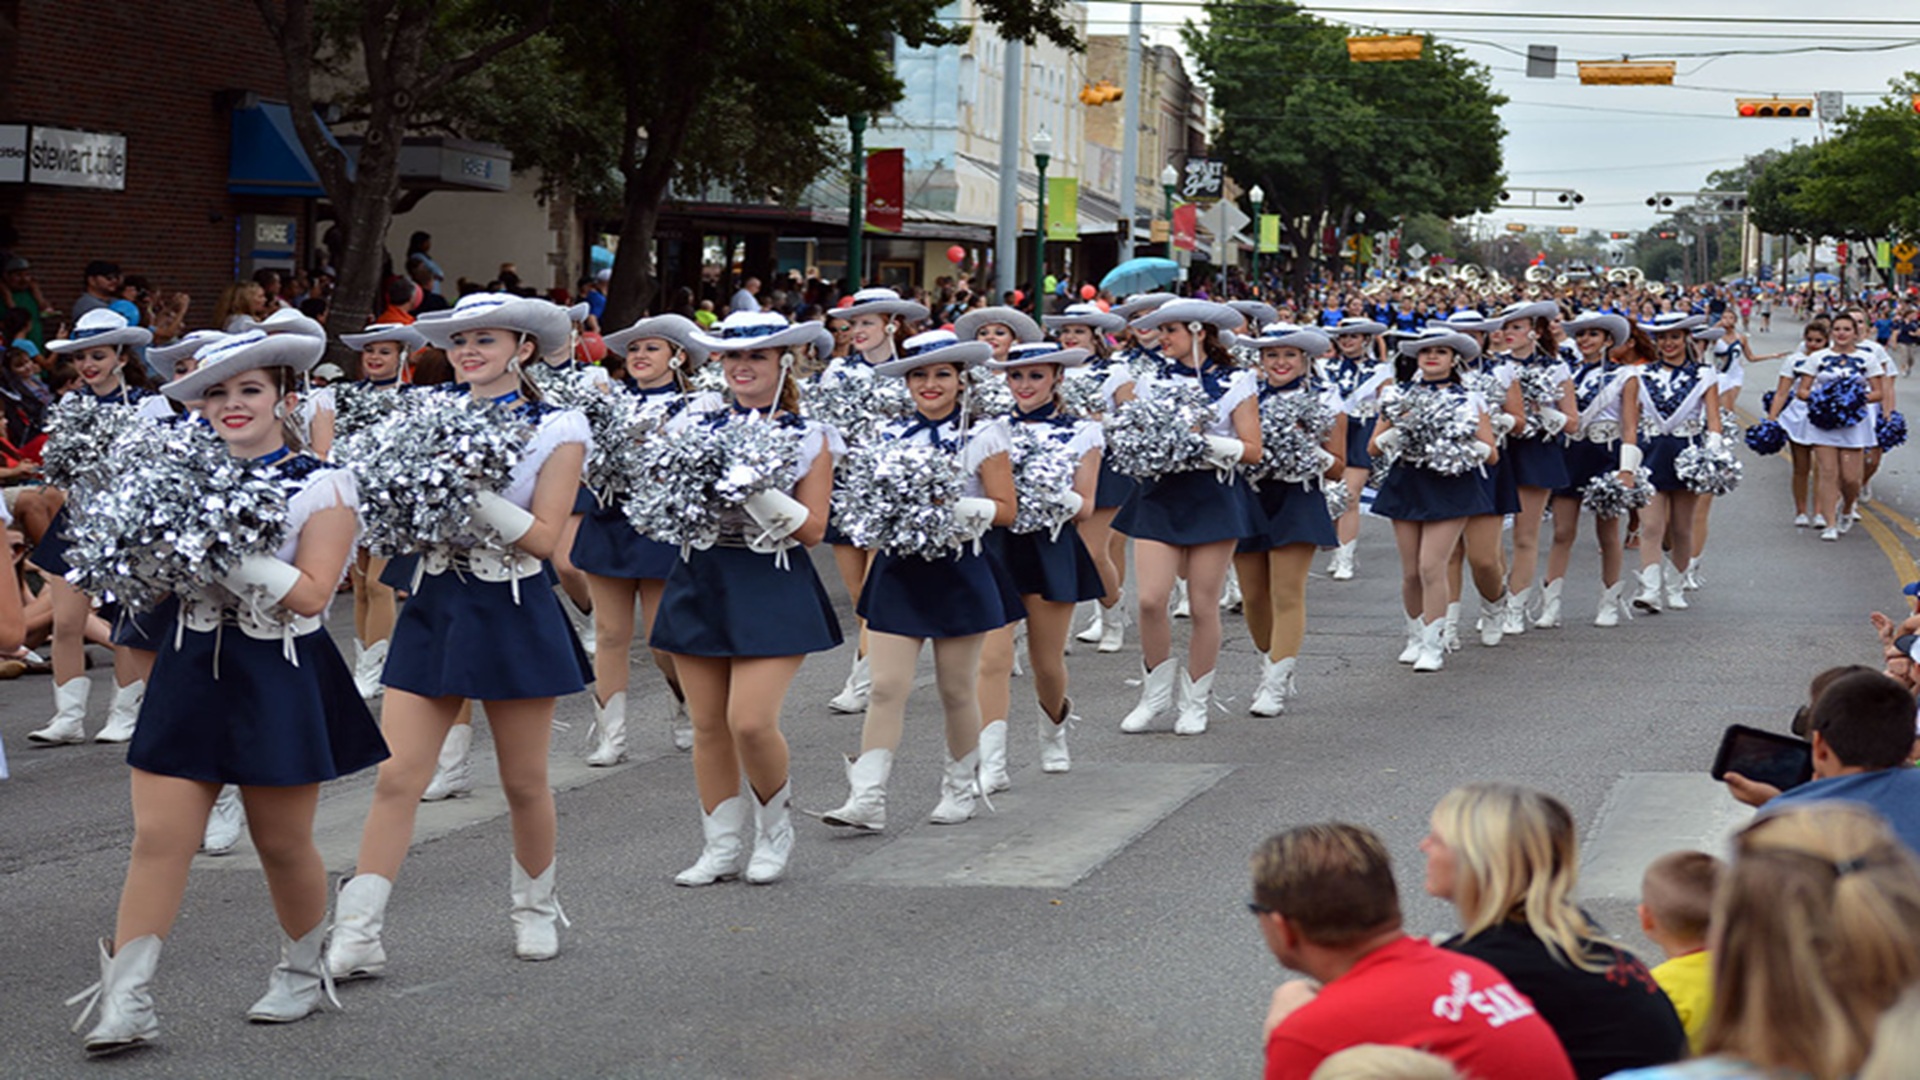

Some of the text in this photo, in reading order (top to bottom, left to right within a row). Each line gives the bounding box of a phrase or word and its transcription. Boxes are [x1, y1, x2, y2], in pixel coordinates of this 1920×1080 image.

[32, 141, 123, 177] stewart title
[256, 222, 288, 243] CHASE
